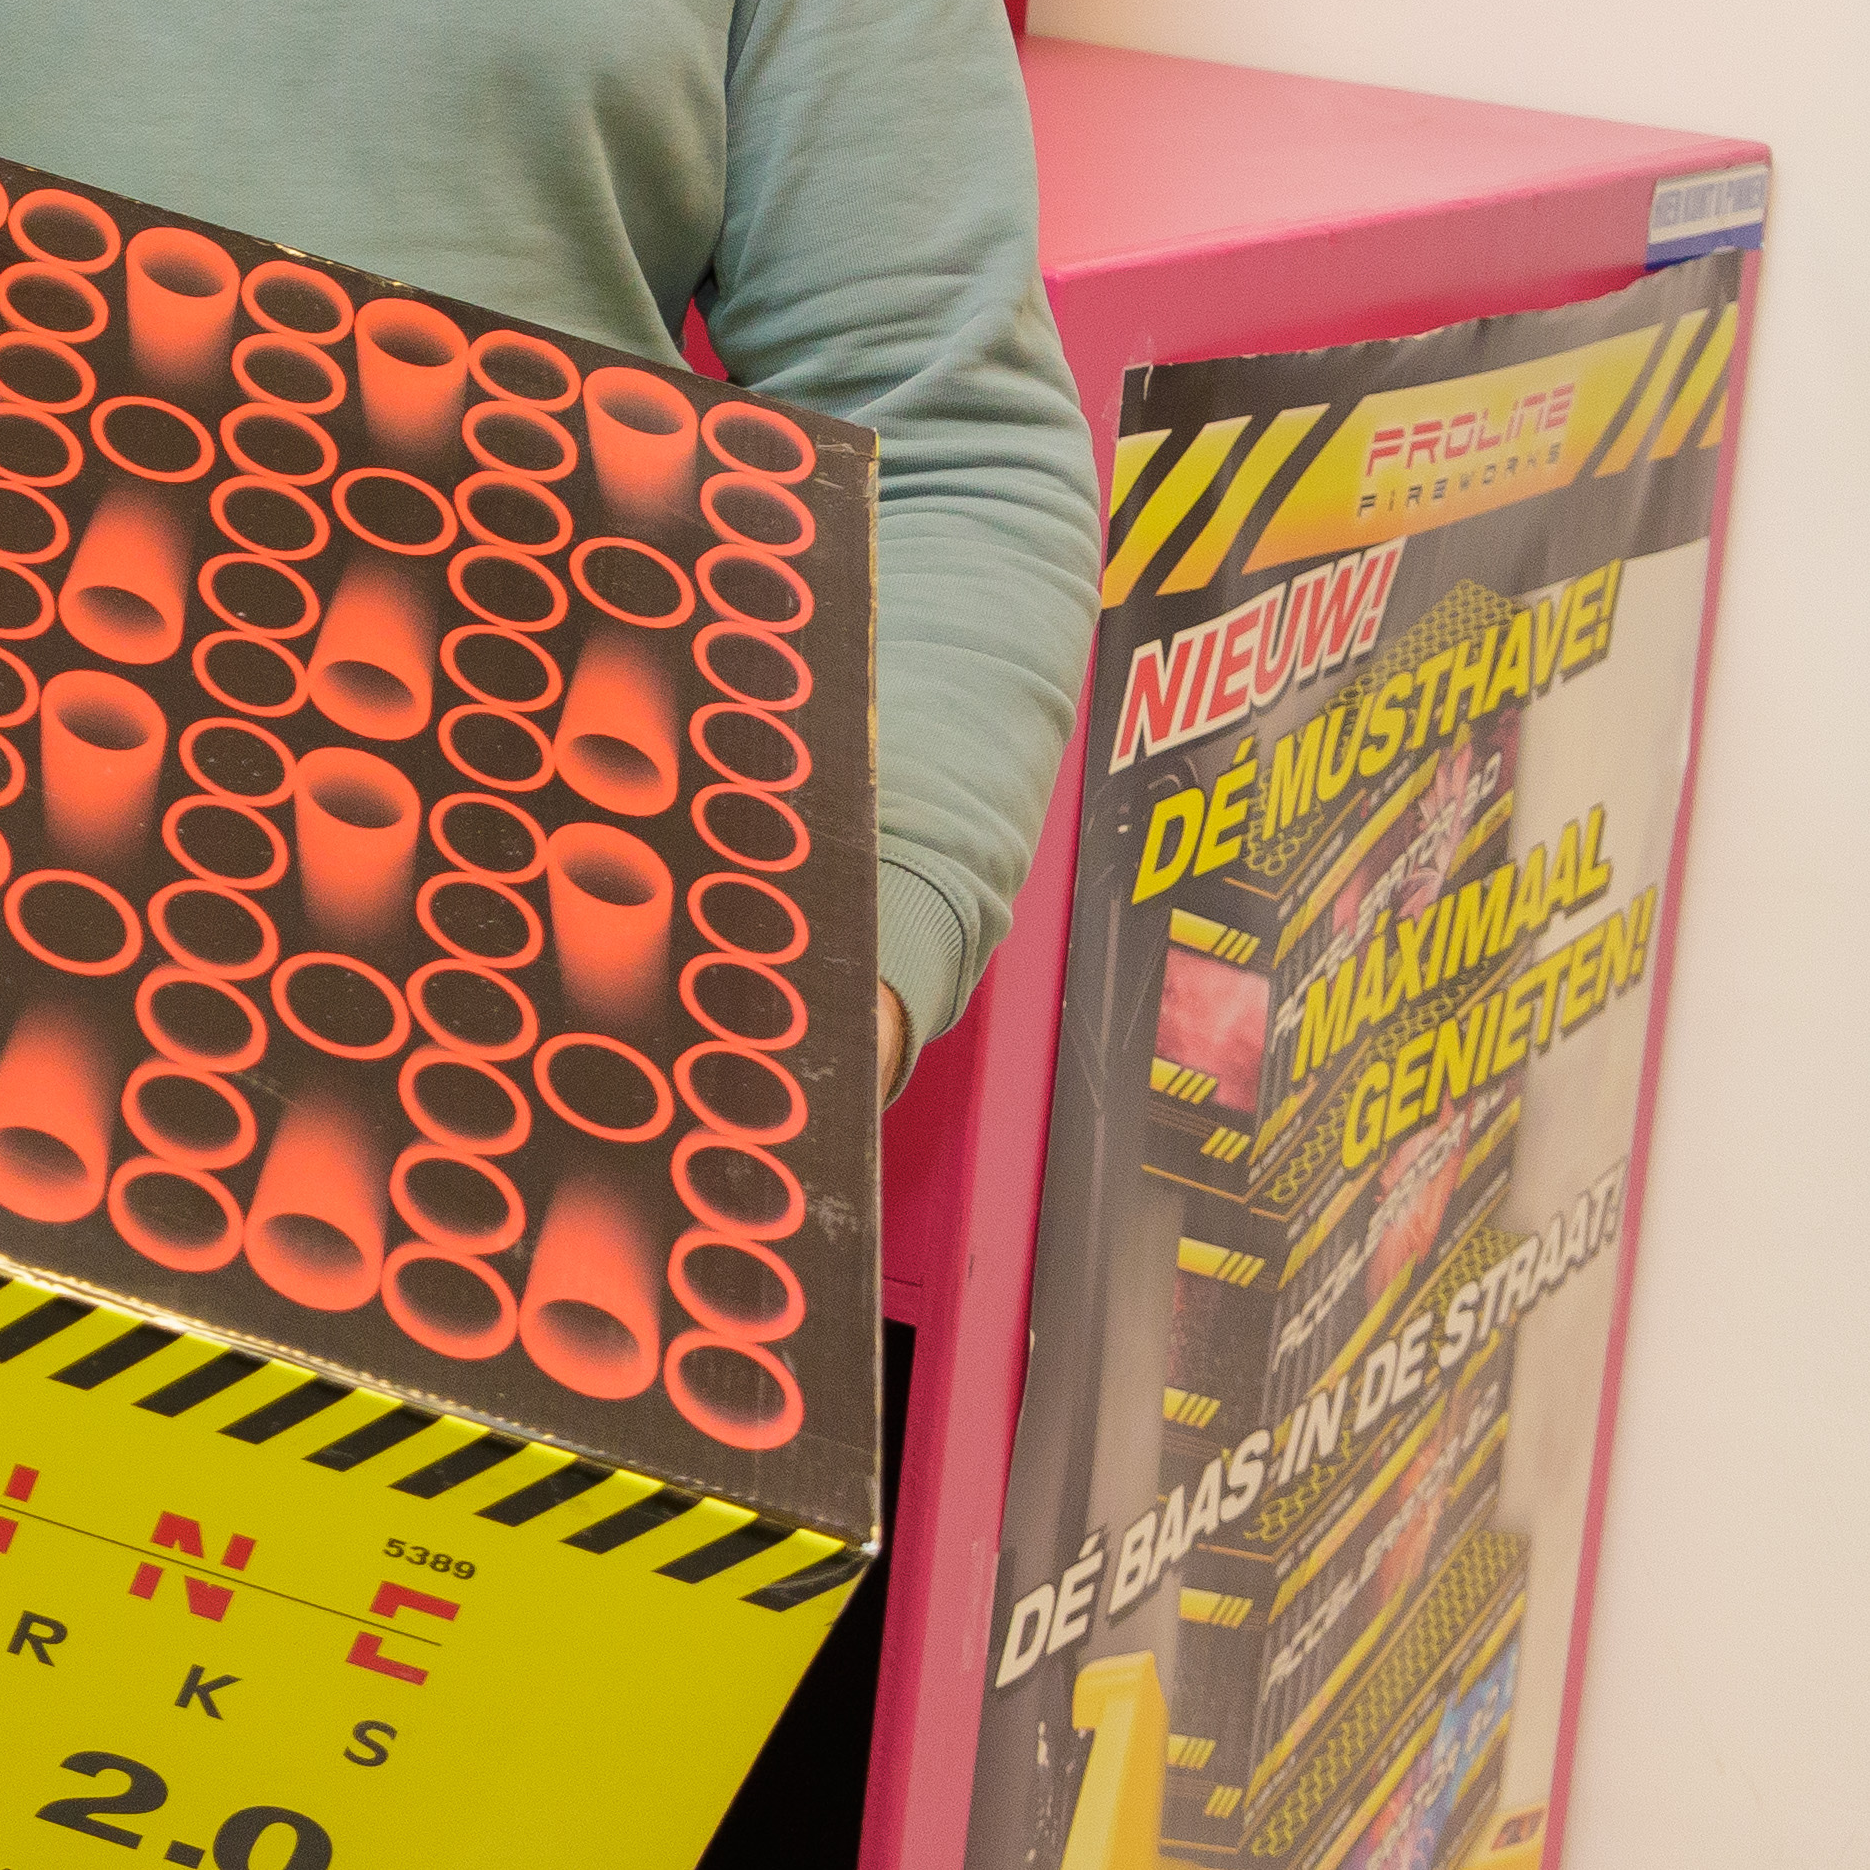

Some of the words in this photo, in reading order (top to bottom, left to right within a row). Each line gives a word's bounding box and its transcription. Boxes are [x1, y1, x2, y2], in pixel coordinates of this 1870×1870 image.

[1357, 440, 1561, 518] FIREWORKS
[1365, 382, 1575, 477] PROLINE
[1111, 538, 1406, 773] NIEUW!
[1132, 737, 1258, 904] DÉ
[1261, 558, 1623, 843] MUSTHAVE!
[1291, 806, 1611, 1082] MÁXIMAAL
[1341, 885, 1658, 1169] GENIETEN!
[996, 1529, 1104, 1689] DÉ
[1107, 1427, 1271, 1620] BAAS
[1276, 1390, 1347, 1487] IN
[1353, 1318, 1434, 1434] DE
[1437, 1156, 1629, 1368] STRAAT!
[383, 1537, 477, 1582] 5389
[35, 1750, 334, 1870] 2.0
